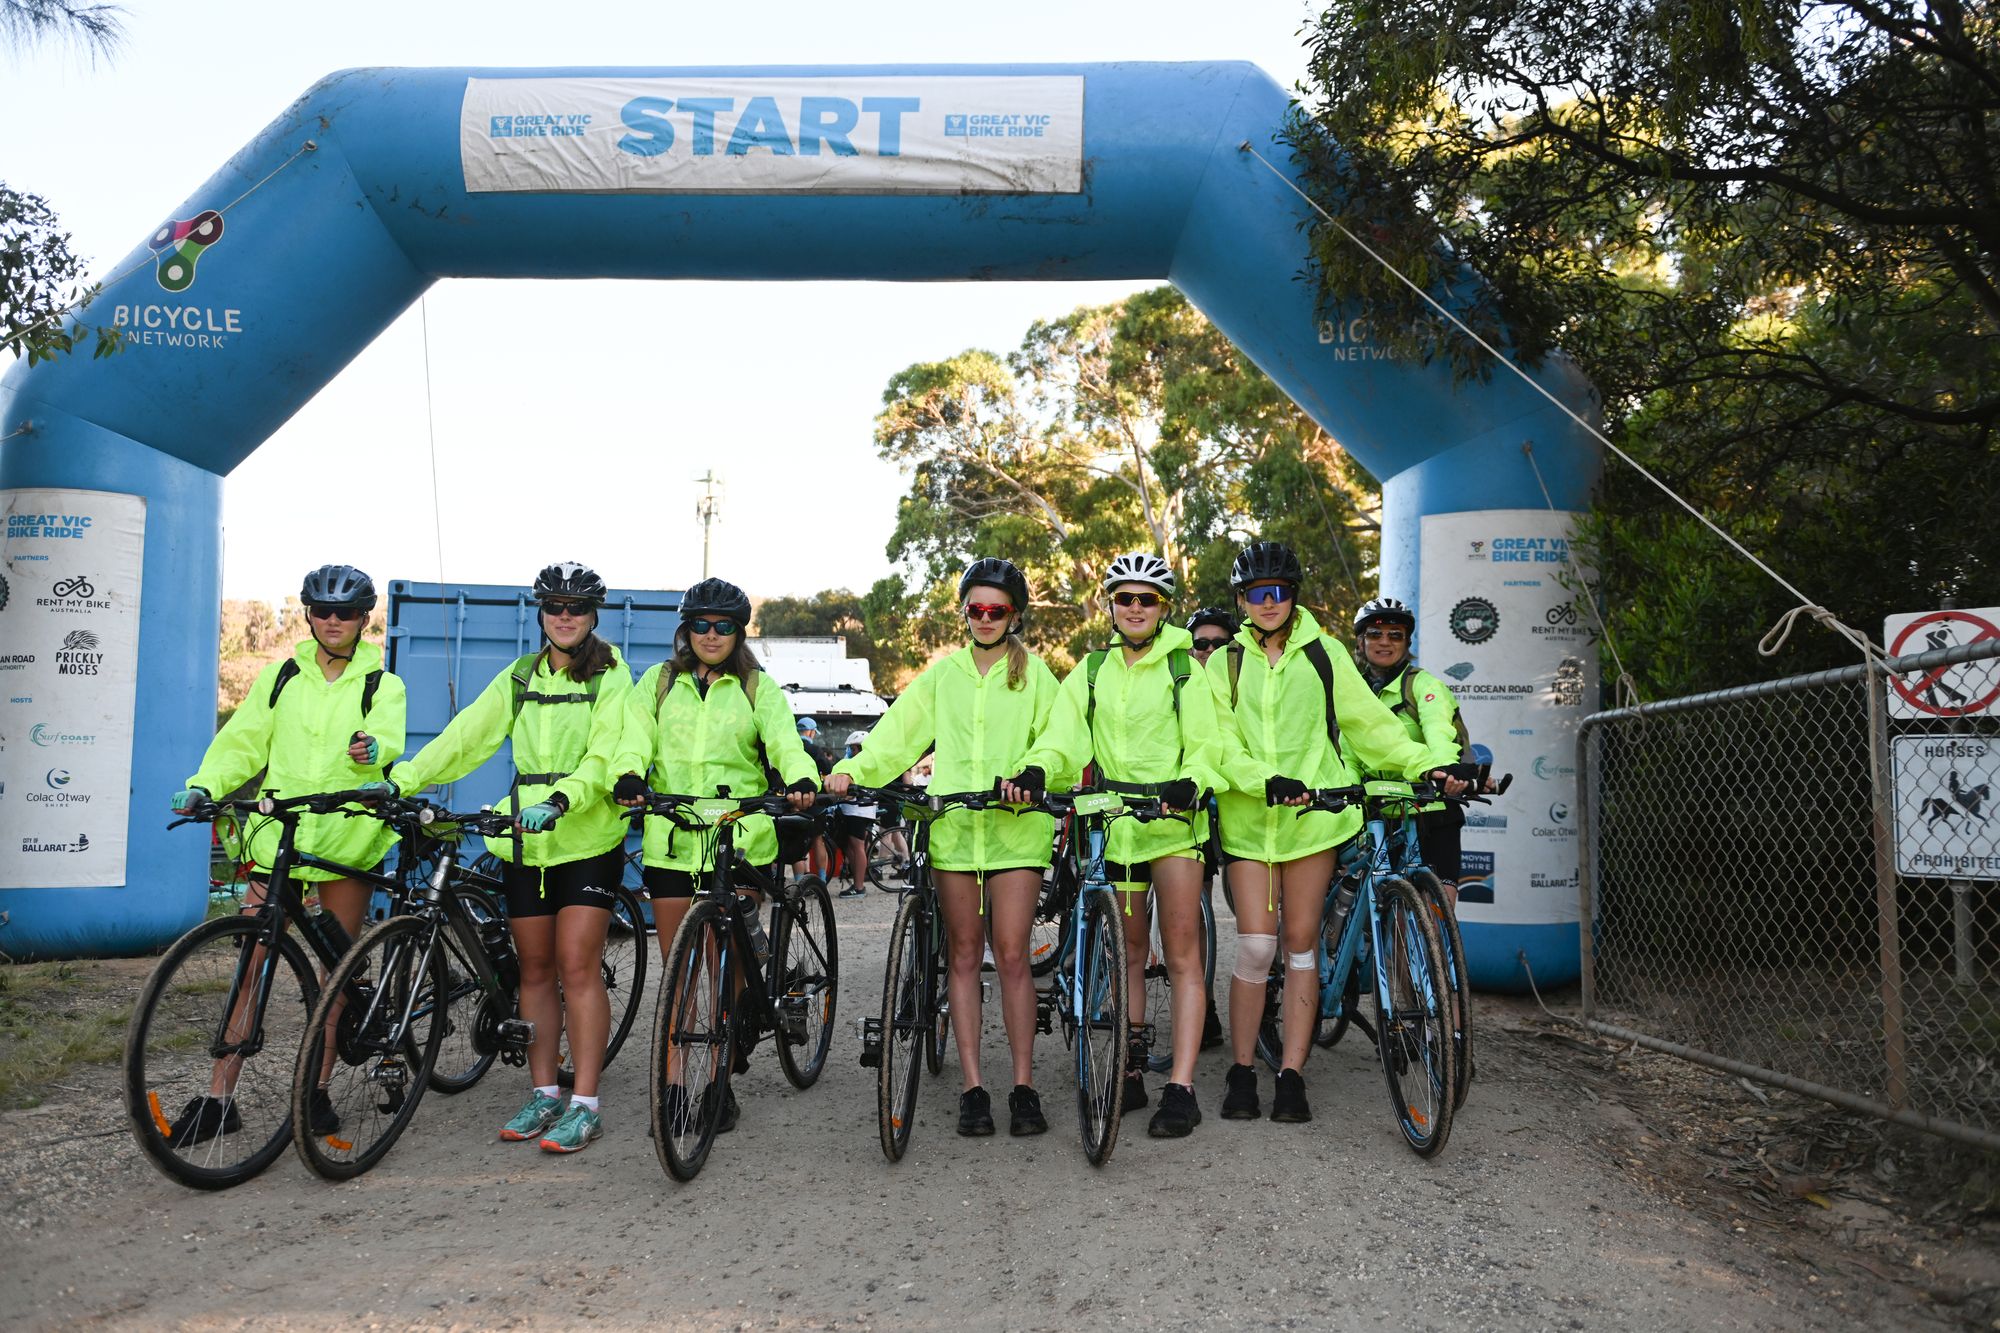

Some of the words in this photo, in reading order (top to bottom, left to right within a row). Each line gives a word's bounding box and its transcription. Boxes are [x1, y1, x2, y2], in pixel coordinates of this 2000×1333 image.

[514, 115, 563, 125] GREAT
[567, 115, 592, 125] VIC
[969, 114, 1021, 125] GREAT
[1024, 114, 1051, 125] VIC
[514, 126, 547, 137] BIKE
[551, 126, 585, 136] RIDE
[616, 96, 920, 157] START
[969, 126, 1004, 136] BIKE
[1008, 126, 1044, 136] RIDE
[114, 305, 243, 332] BICYCLE
[128, 331, 224, 348] NETWORK
[8, 515, 57, 526] GREAT
[62, 515, 93, 528] VIC
[7, 527, 39, 539] BIKE
[43, 527, 83, 539] RIDE
[1492, 538, 1546, 549] GREAT
[1492, 551, 1530, 562] BIKE
[1533, 551, 1569, 563] RIDE
[37, 598, 63, 606] RENT
[66, 600, 83, 608] MY
[86, 600, 111, 609] BIKE
[1532, 626, 1555, 634] RENT
[12, 655, 35, 663] ROAD
[56, 652, 103, 664] PRICKLY
[59, 664, 98, 676] MOSES
[1446, 685, 1471, 693] REAT
[1473, 685, 1506, 693] OCEAN
[1508, 685, 1534, 693] ROAD
[1925, 746, 1985, 758] HORSES
[26, 792, 54, 802] Colac
[56, 792, 91, 804] Otway
[1532, 827, 1556, 837] Colac
[1558, 827, 1578, 837] Otwa
[22, 844, 67, 852] BALLARAT
